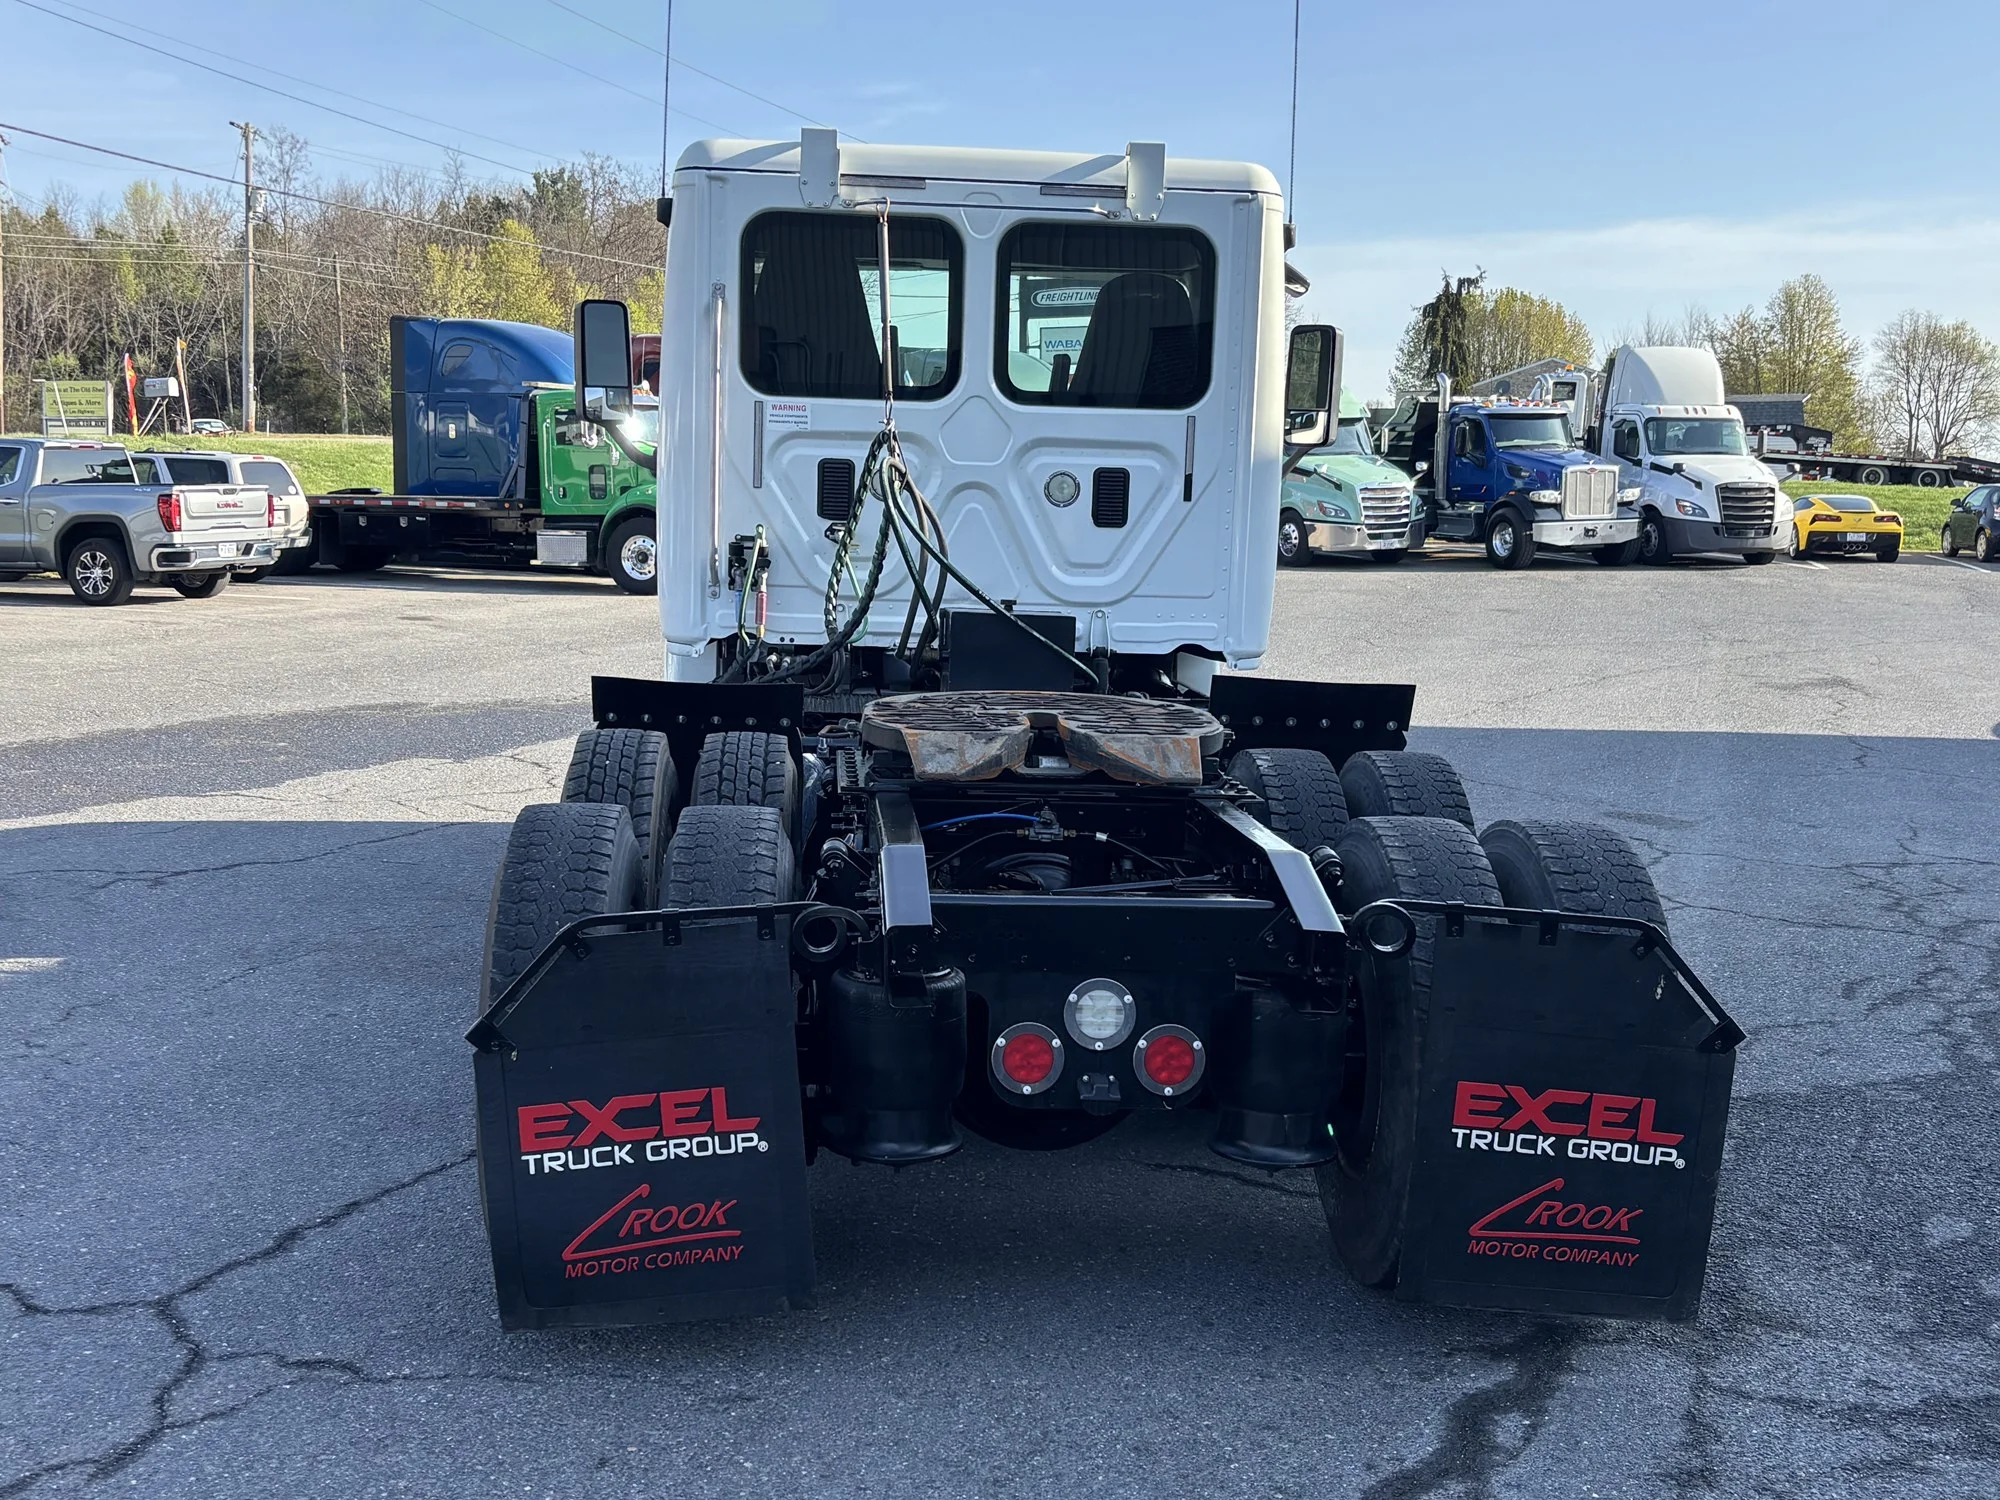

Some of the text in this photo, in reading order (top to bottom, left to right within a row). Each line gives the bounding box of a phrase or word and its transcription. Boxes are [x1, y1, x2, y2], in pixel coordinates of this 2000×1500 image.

[771, 404, 807, 412] WARNING
[517, 1087, 761, 1152] EXCEL
[1453, 1081, 1685, 1145] EXCEL
[1451, 1128, 1555, 1156] TRUCK
[520, 1144, 634, 1175] TRUCK
[565, 1244, 744, 1279] MOTOR COMPANY
[1467, 1239, 1640, 1267] MOTOR COMPANY
